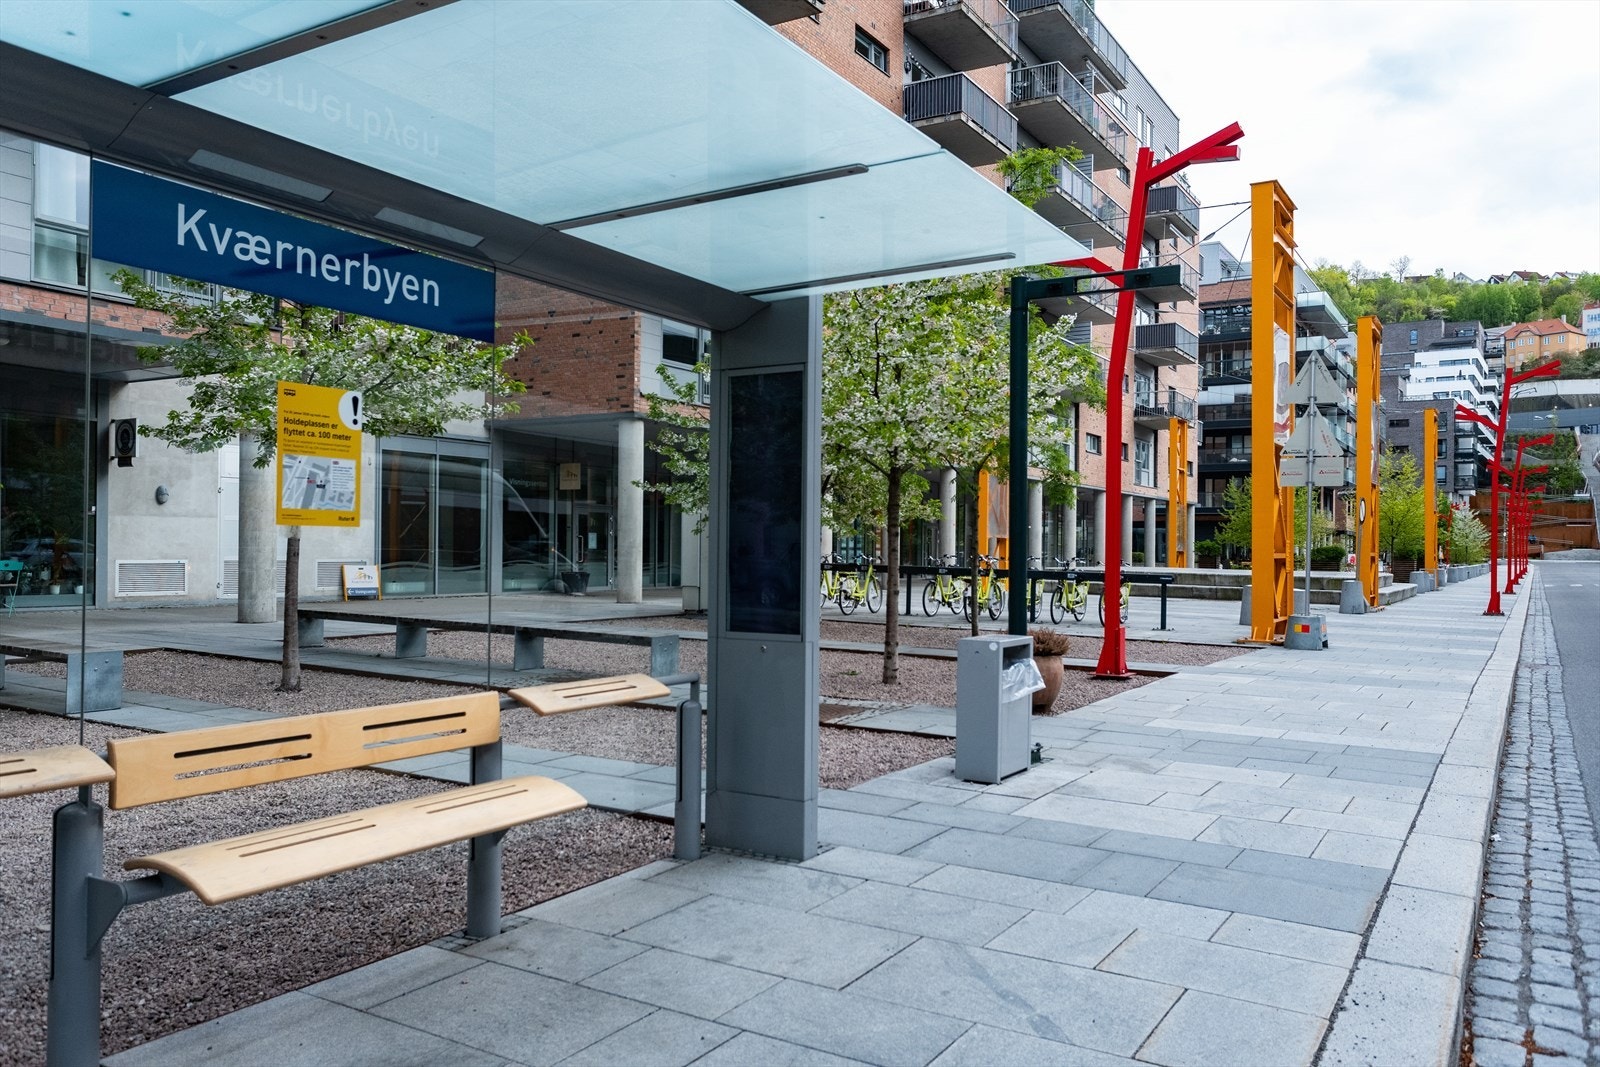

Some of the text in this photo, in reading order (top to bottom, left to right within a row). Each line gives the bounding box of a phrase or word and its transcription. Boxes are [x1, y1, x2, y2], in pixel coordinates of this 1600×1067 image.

[177, 203, 440, 307] Kværnerbyen
[283, 416, 329, 429] Holdeplassen
[283, 427, 305, 437] flyttet
[318, 431, 331, 439] 100
[332, 433, 352, 441] meter
